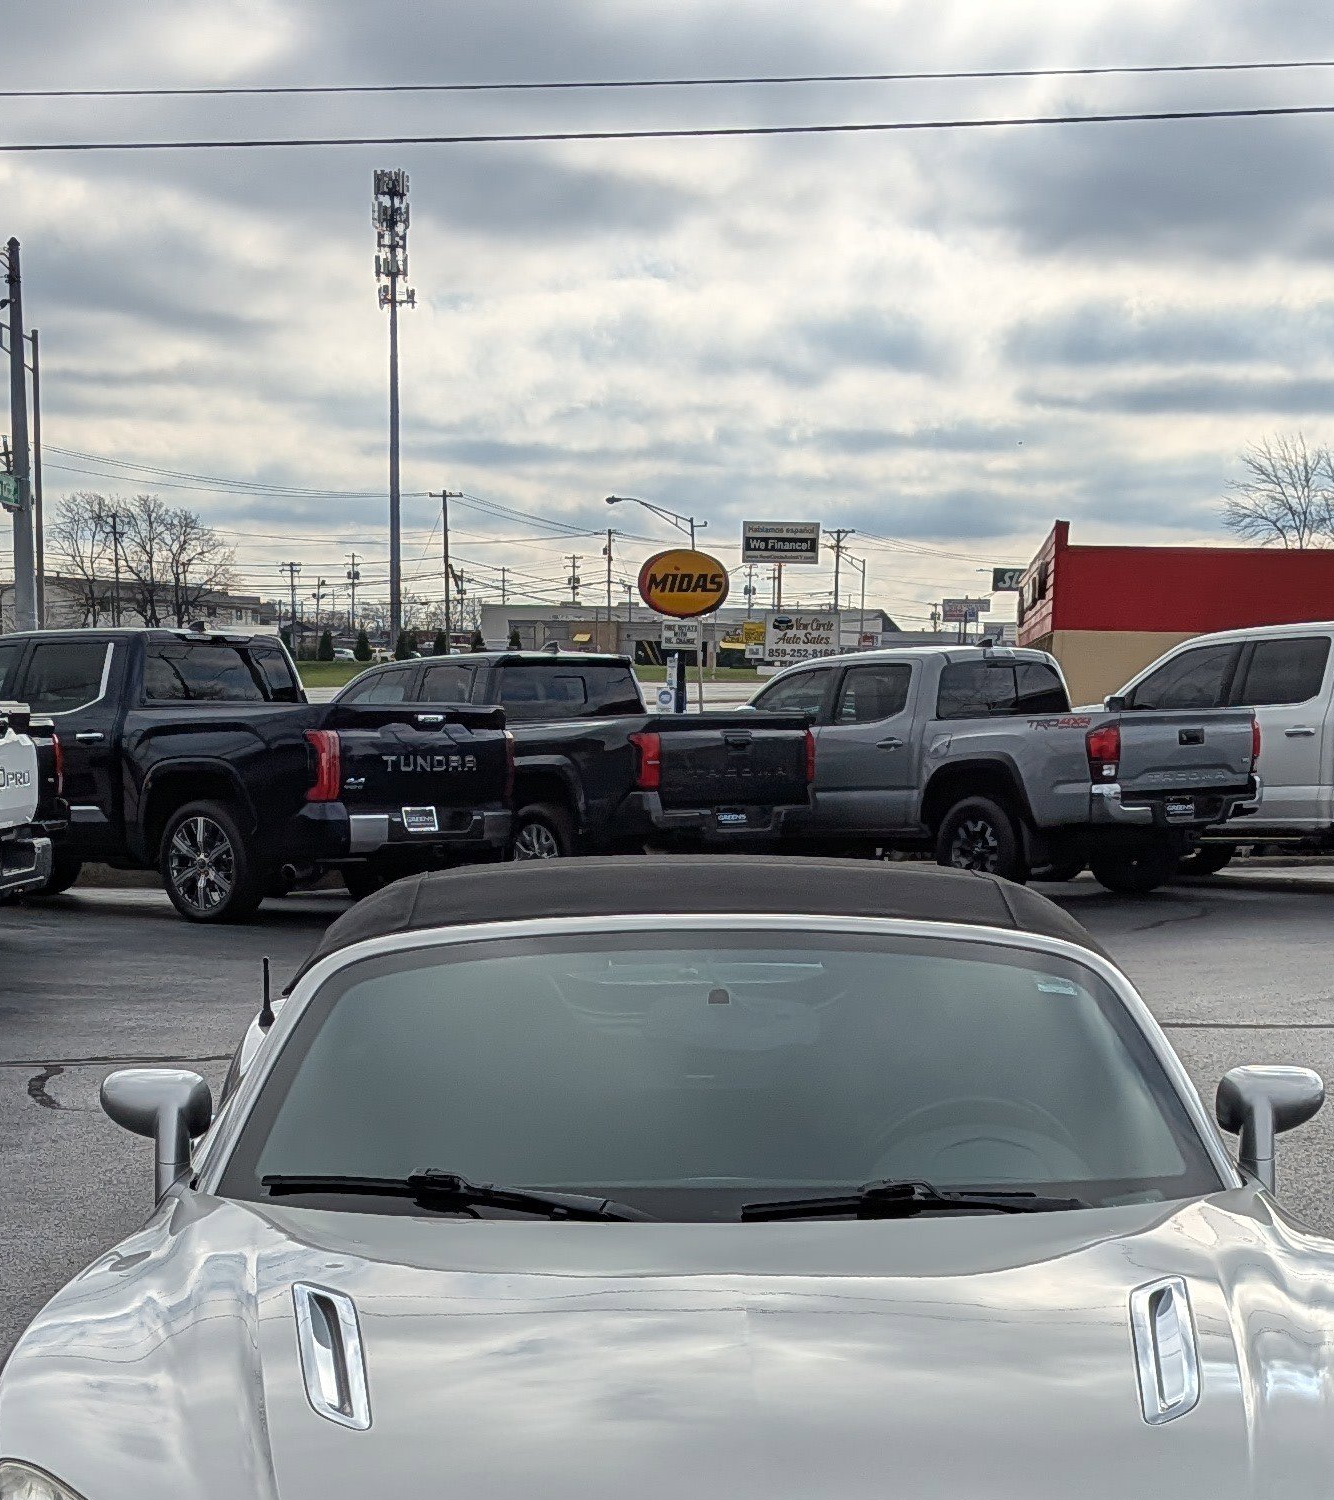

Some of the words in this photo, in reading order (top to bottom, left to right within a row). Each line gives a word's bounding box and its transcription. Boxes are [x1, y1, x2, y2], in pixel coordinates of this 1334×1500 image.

[747, 525, 784, 533] Hablamos
[749, 539, 765, 549] We
[767, 539, 811, 550] Finance!
[647, 571, 724, 593] MIDAS
[810, 617, 835, 631] Circle
[774, 631, 801, 645] Auto
[802, 631, 831, 645] Sales
[381, 754, 477, 772] TUNDRA
[6, 769, 31, 788] PRO
